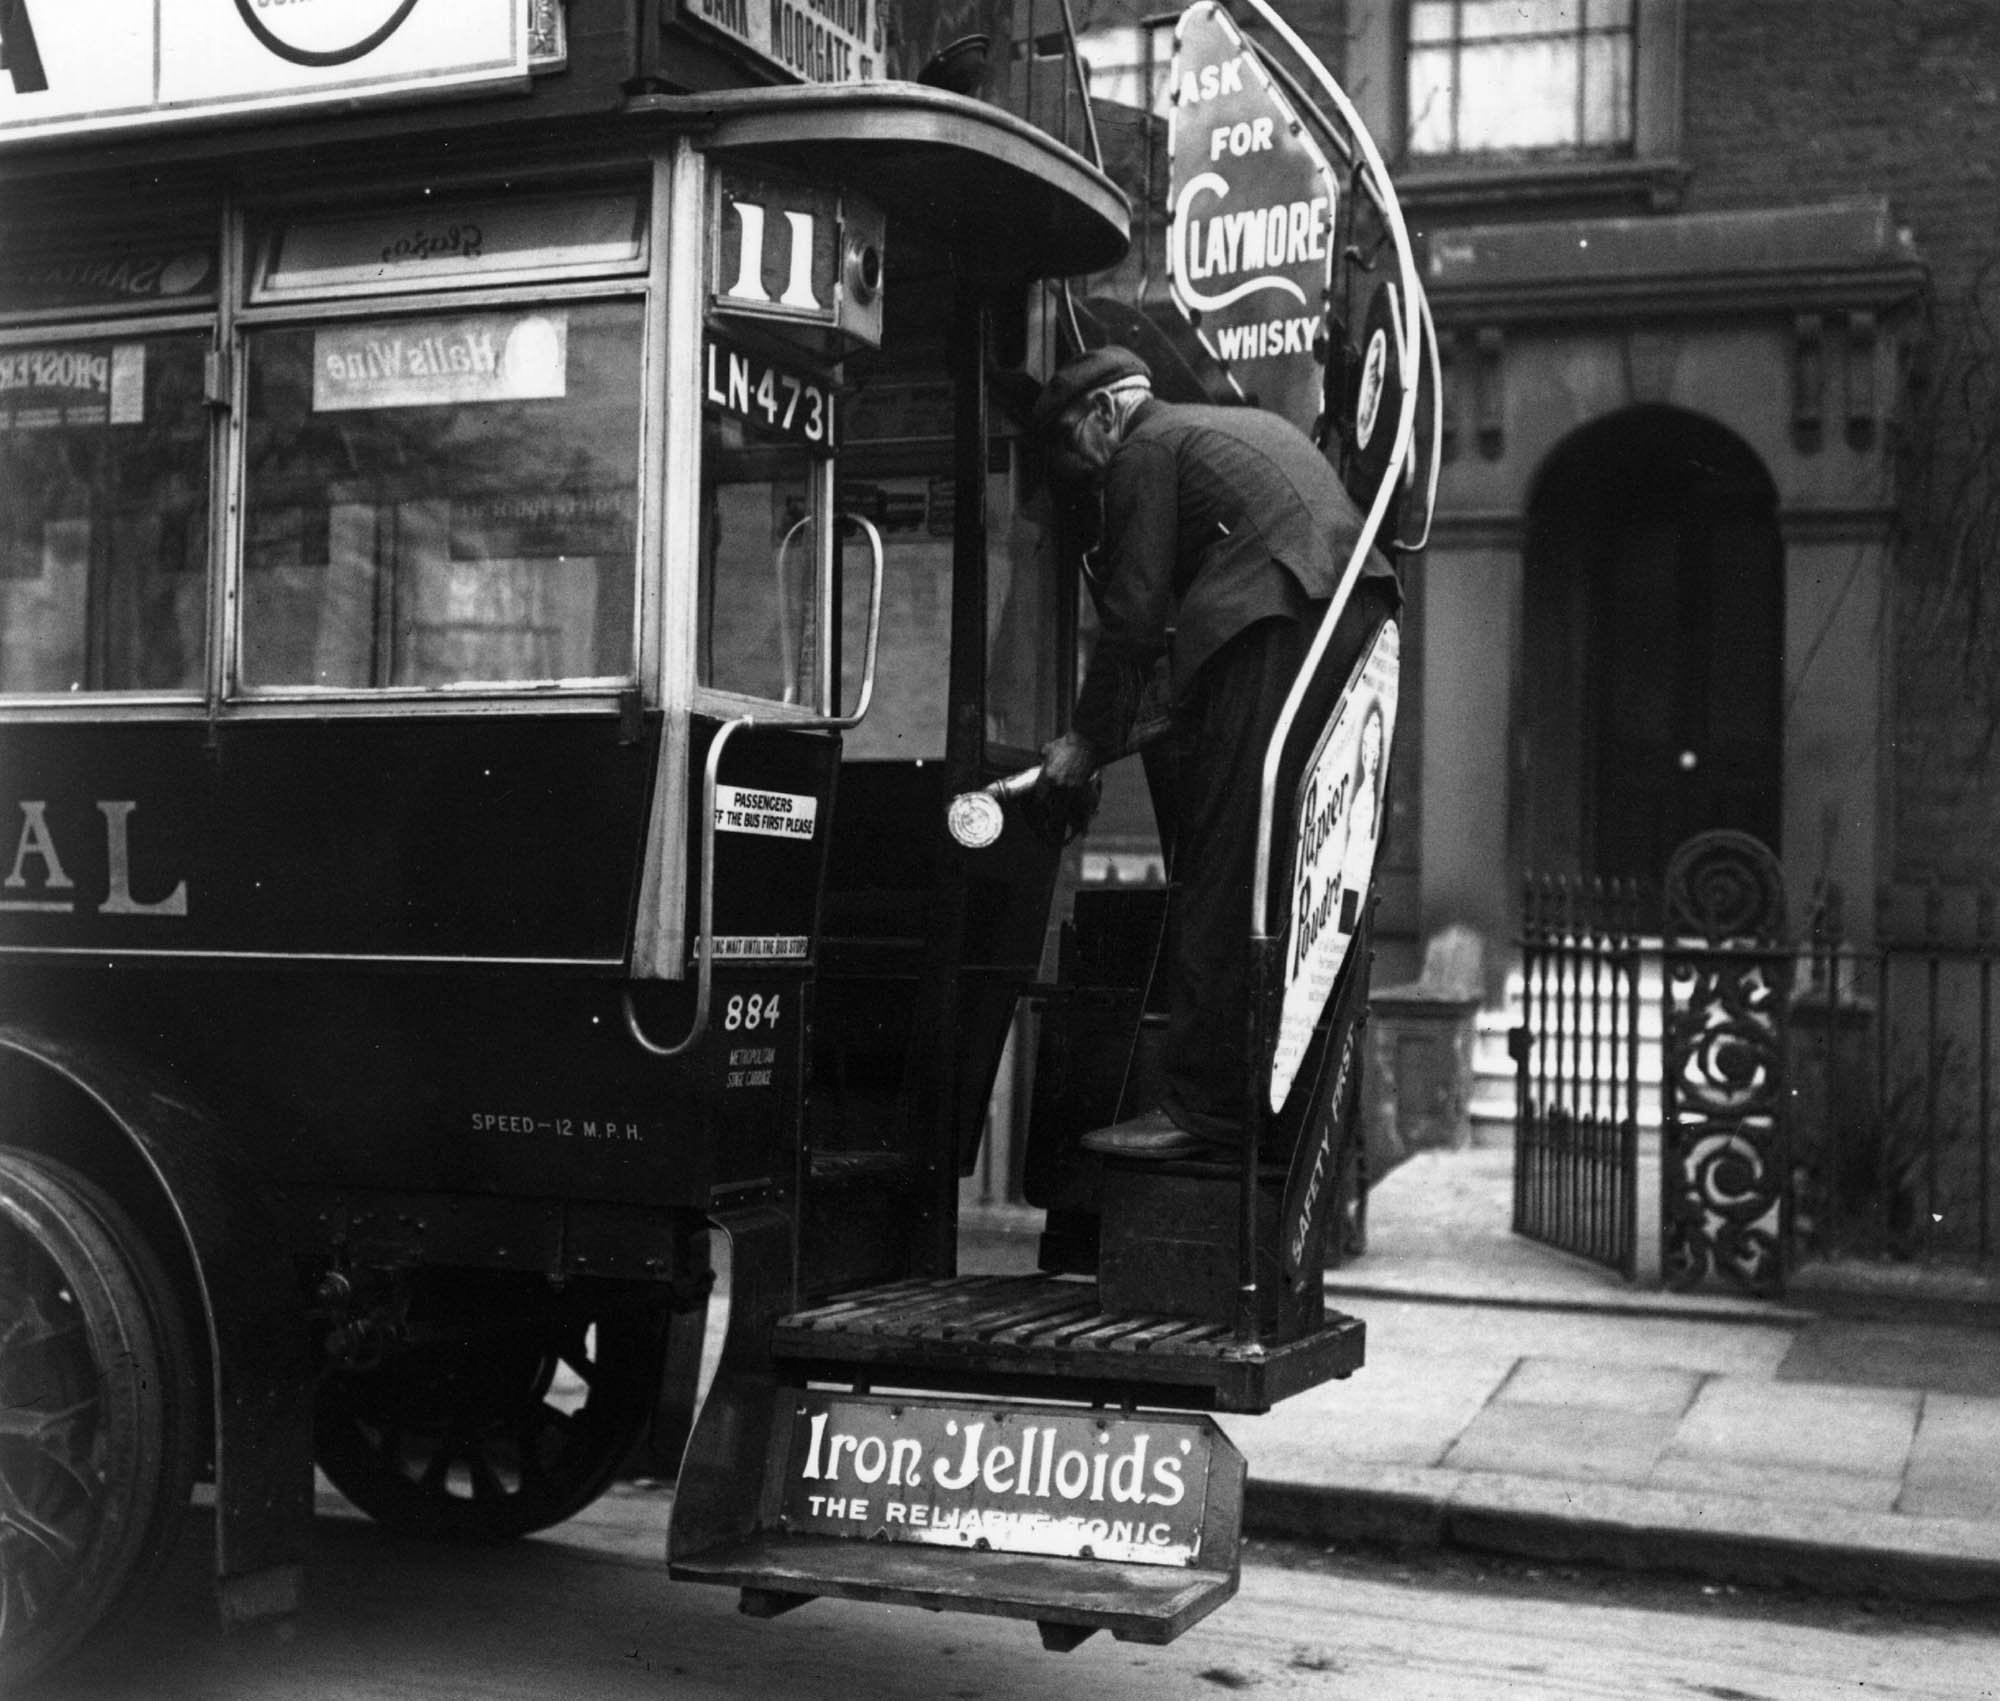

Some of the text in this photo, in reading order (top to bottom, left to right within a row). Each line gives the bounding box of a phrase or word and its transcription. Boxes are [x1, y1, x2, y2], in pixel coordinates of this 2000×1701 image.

[770, 0, 852, 82] MOORGATE
[1179, 57, 1244, 107] ASK
[1210, 116, 1275, 161] FOR
[727, 201, 822, 310] 11
[1173, 171, 1330, 313] CLAYMORE
[1217, 315, 1322, 361] WHISKY
[727, 810, 743, 827] THE
[743, 812, 760, 829] BUS
[760, 814, 784, 832] FIRST
[785, 818, 814, 836] PLEASE
[733, 792, 794, 814] PASSENGERS
[724, 993, 780, 1031] 884
[1292, 1125, 1330, 1265] SAFETY
[802, 1412, 923, 1488] Iron
[808, 1496, 870, 1522] THE
